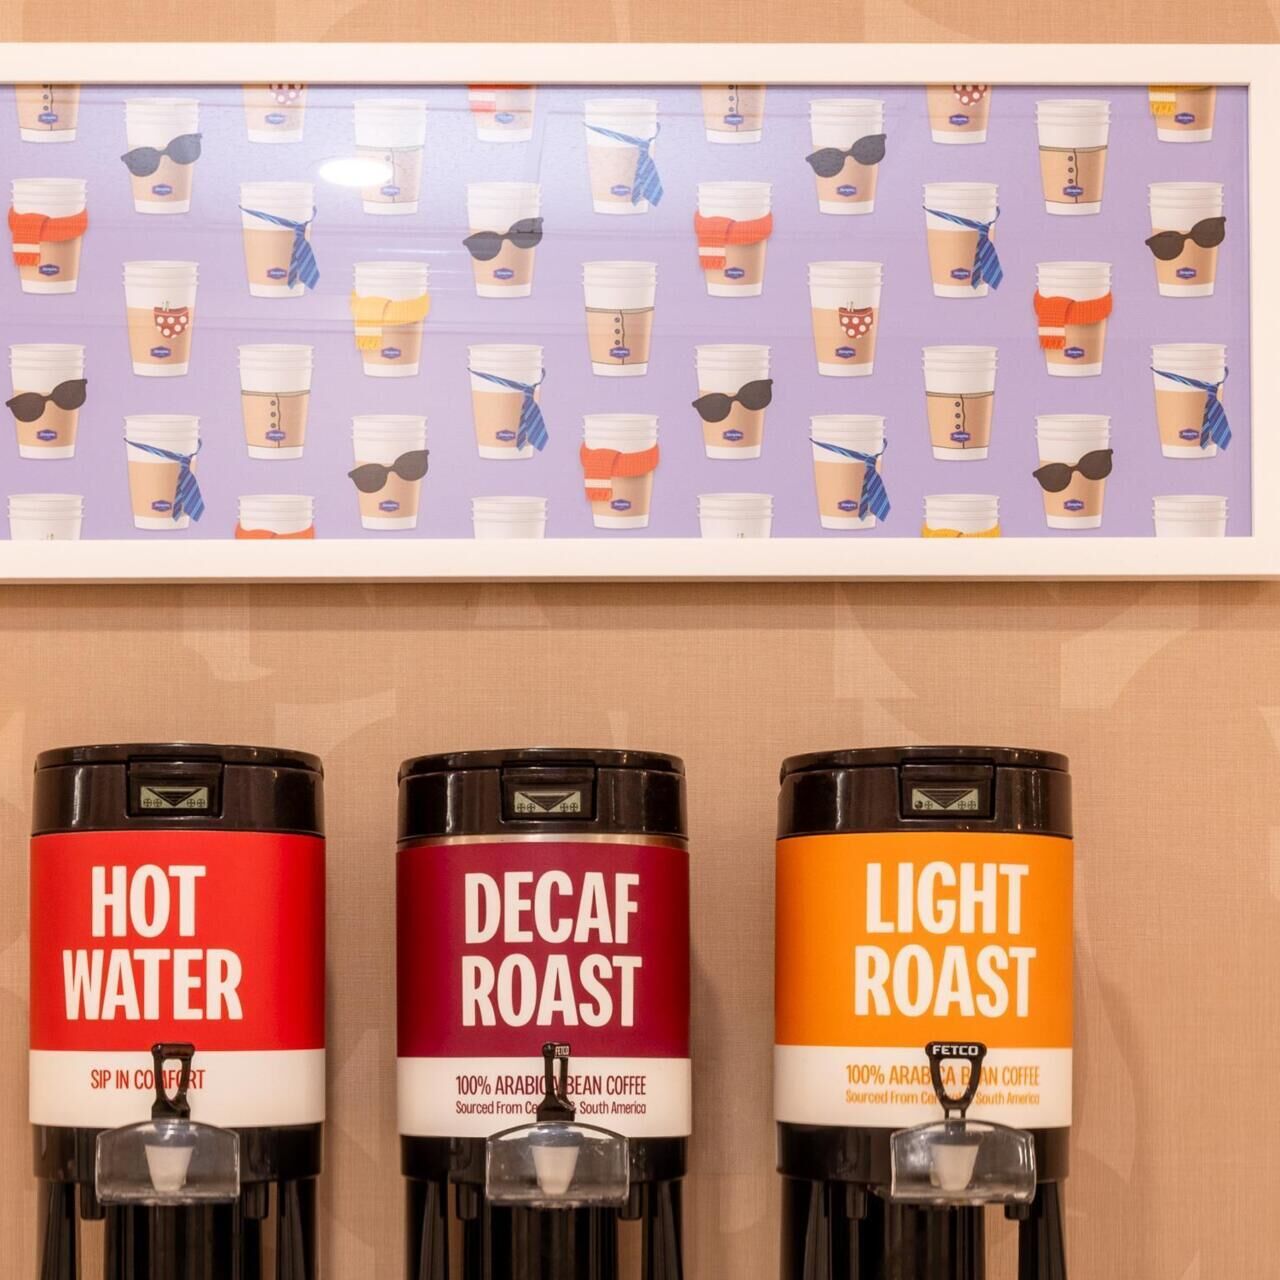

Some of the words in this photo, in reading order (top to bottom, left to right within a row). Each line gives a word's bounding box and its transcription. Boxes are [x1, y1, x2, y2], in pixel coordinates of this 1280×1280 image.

[91, 864, 206, 937] HOT
[465, 870, 640, 944] DECAF
[866, 861, 1029, 935] LIGHT
[63, 949, 243, 1021] WATER
[461, 953, 642, 1027] ROAST
[854, 945, 1037, 1018] ROAST
[932, 1045, 979, 1056] FETCO
[90, 1069, 112, 1089] SIP
[116, 1069, 130, 1089] IN
[456, 1075, 491, 1095] 100%
[566, 1075, 602, 1095] BEAN
[606, 1075, 646, 1095] COFFEE
[846, 1064, 885, 1085] 100%
[889, 1065, 956, 1086] ARABA
[961, 1066, 998, 1086] BAN
[1002, 1066, 1040, 1086] COFFEE
[456, 1101, 494, 1114] Sourced
[497, 1101, 523, 1114] From
[580, 1101, 609, 1114] South
[611, 1101, 646, 1114] America
[846, 1090, 888, 1104] Sourced
[891, 1090, 918, 1104] From
[975, 1092, 1005, 1105] South
[1007, 1092, 1040, 1105] America
